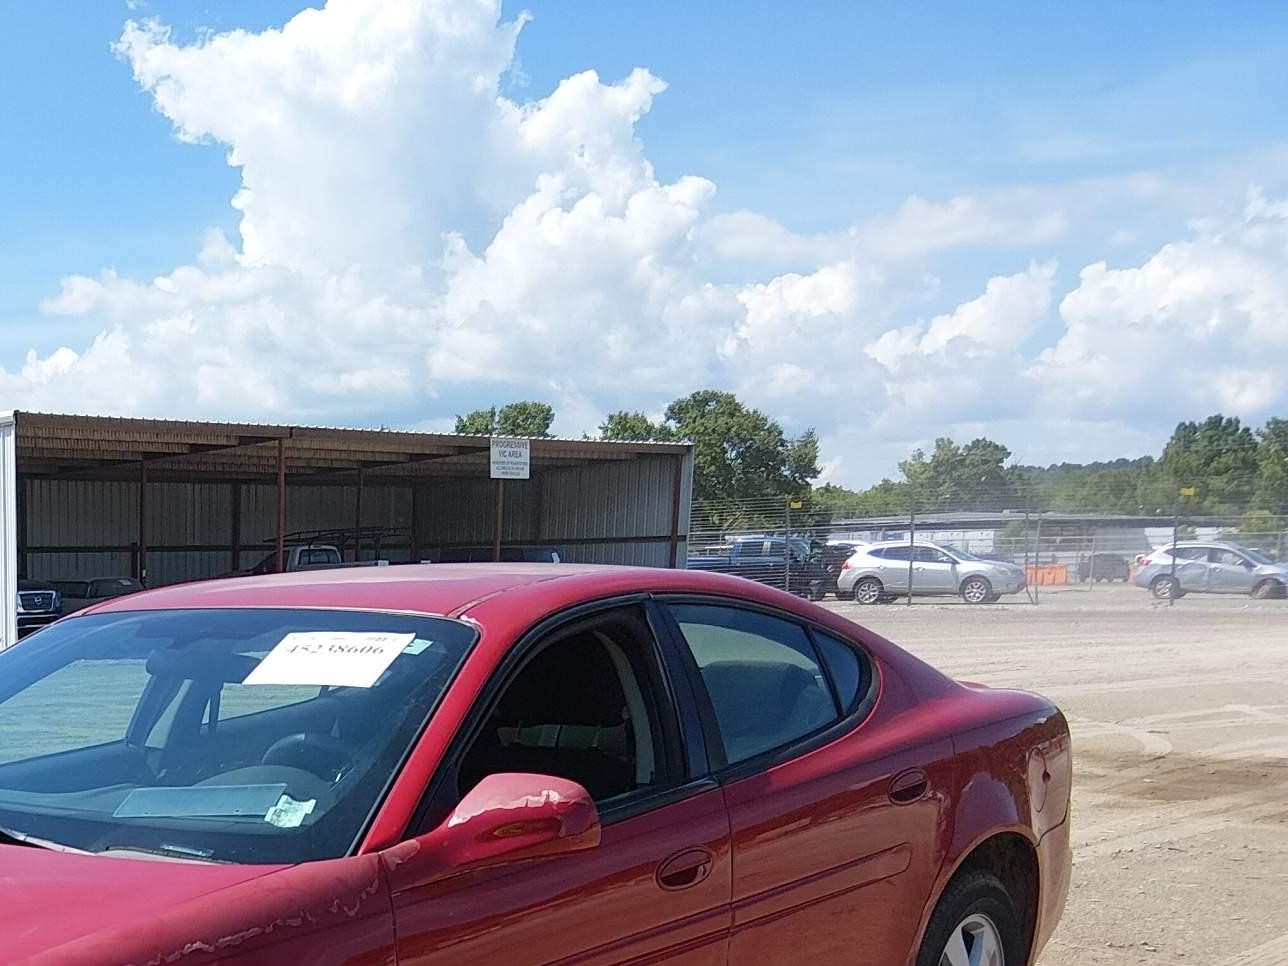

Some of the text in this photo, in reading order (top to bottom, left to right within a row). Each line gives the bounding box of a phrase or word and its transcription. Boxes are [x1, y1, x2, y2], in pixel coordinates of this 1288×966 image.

[492, 440, 528, 449] PROGRESSIVE
[508, 450, 522, 458] AREA
[287, 644, 385, 654] 45238606
